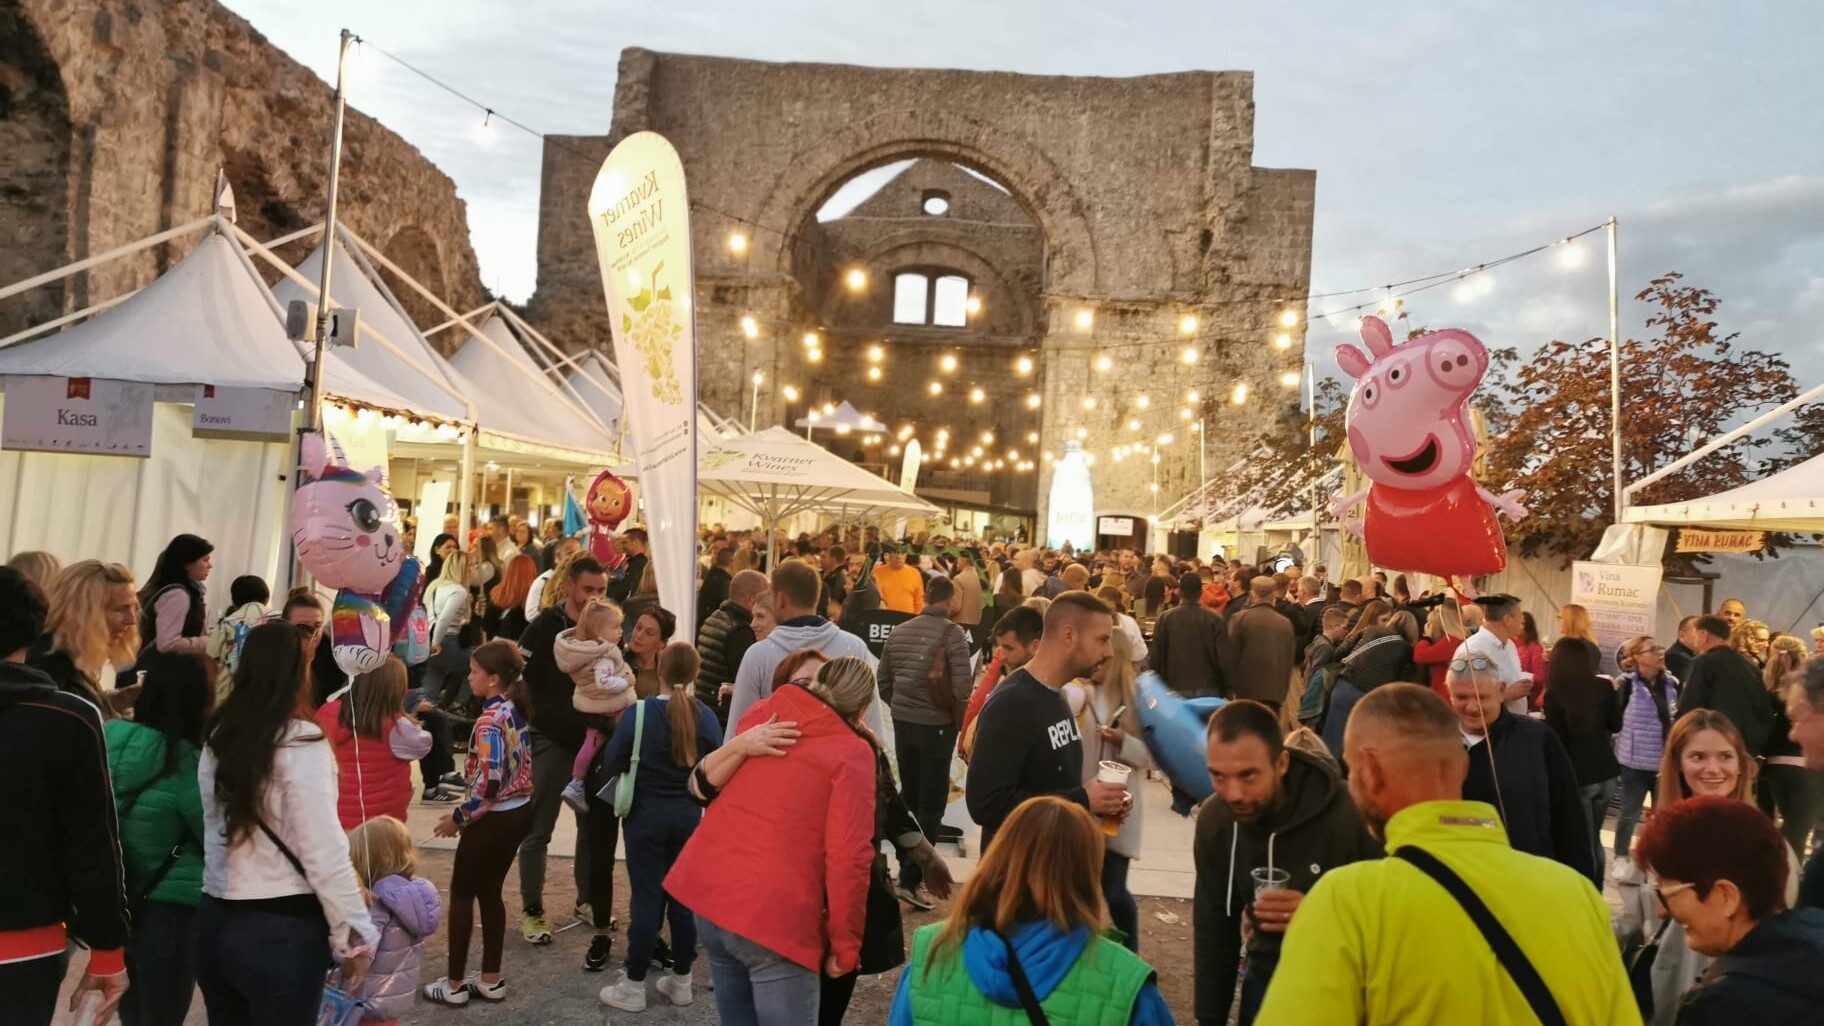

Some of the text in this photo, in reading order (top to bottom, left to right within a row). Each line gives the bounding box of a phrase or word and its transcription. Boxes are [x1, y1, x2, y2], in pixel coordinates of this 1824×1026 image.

[56, 409, 98, 427] Kasa
[199, 414, 232, 425] Bonovi
[752, 452, 815, 466] Kvarner
[748, 461, 799, 472] Wines
[1684, 533, 1753, 549] VINA RUMAC
[1599, 570, 1621, 582] Vina
[1597, 583, 1640, 598] Rumac
